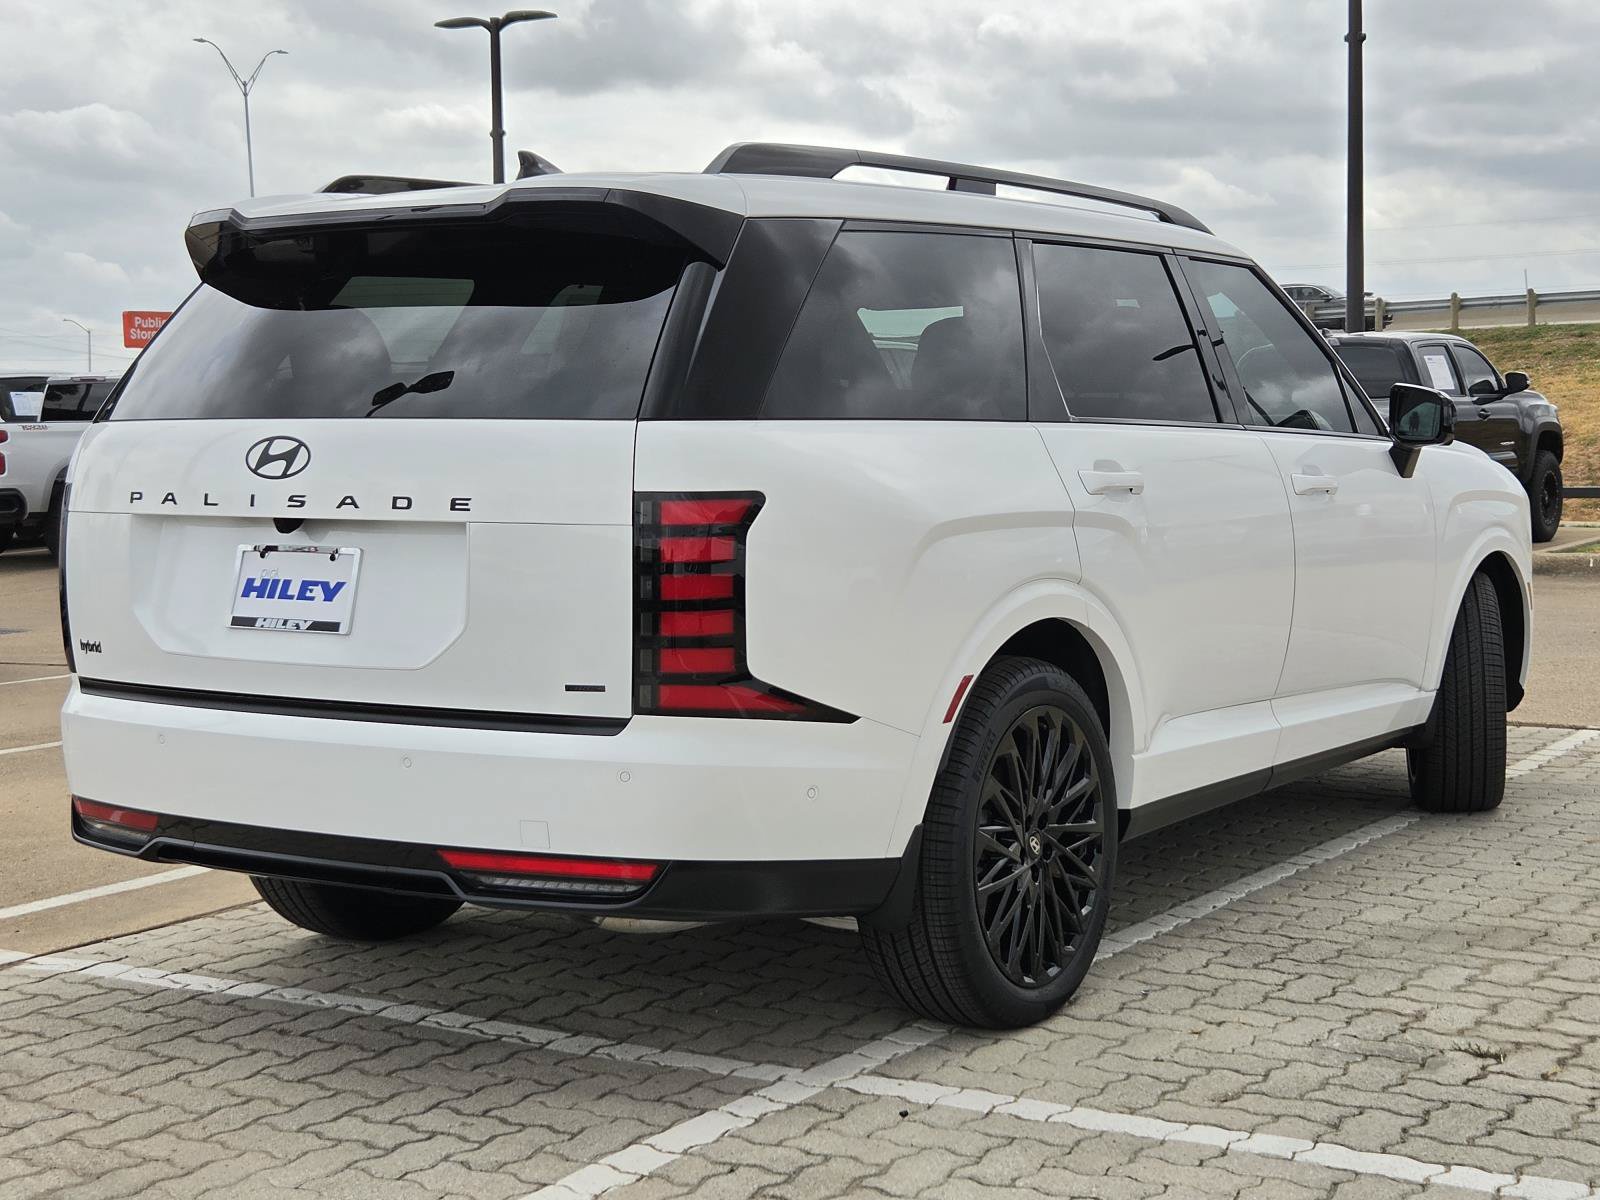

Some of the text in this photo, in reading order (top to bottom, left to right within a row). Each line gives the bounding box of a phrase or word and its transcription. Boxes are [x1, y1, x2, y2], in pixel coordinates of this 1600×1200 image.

[129, 491, 472, 512] PALISADE
[240, 577, 347, 603] HILEY
[255, 617, 314, 631] HILEY
[79, 638, 102, 655] hybrid
